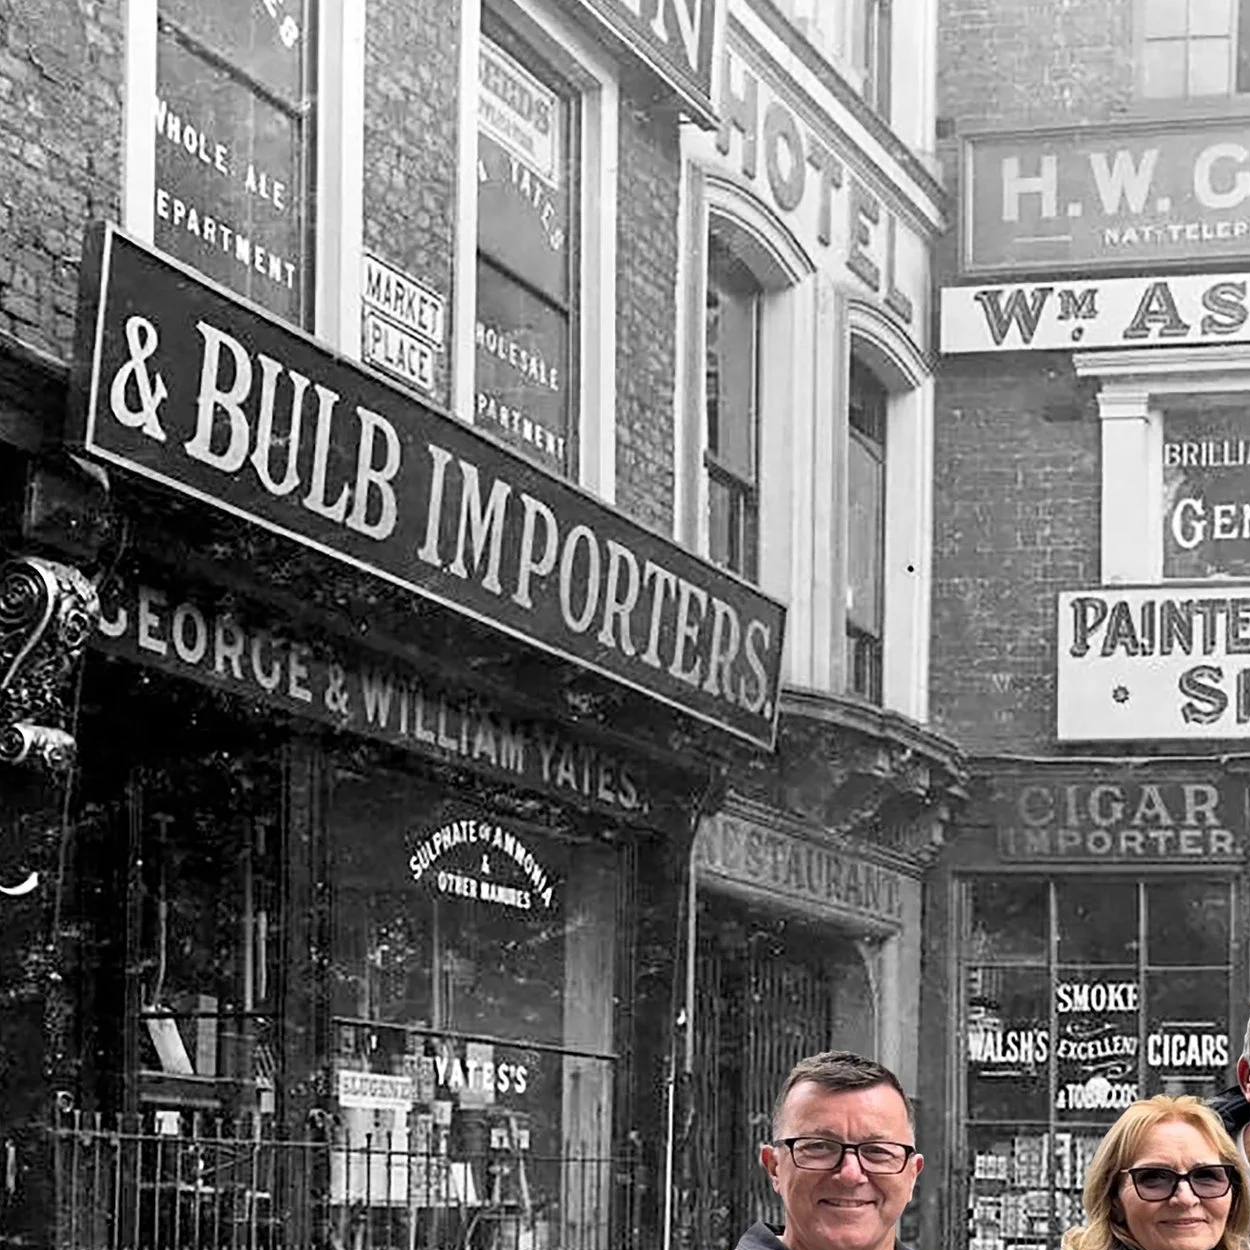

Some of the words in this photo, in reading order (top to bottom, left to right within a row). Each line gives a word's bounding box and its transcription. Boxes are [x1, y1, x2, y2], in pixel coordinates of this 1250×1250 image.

[716, 46, 912, 325] HOTEL
[366, 263, 440, 335] MARKET
[371, 322, 429, 384] PLACE
[110, 315, 169, 442] &
[184, 320, 401, 541] BULB
[416, 443, 774, 720] IMPORTERS.
[324, 662, 349, 716] &
[1020, 784, 1222, 827] CIGAR
[409, 820, 478, 881] SULPHATE
[1057, 983, 1139, 1013] SMOKE
[967, 1029, 1049, 1063] WALSH'S
[1147, 1033, 1229, 1067] CIGARS
